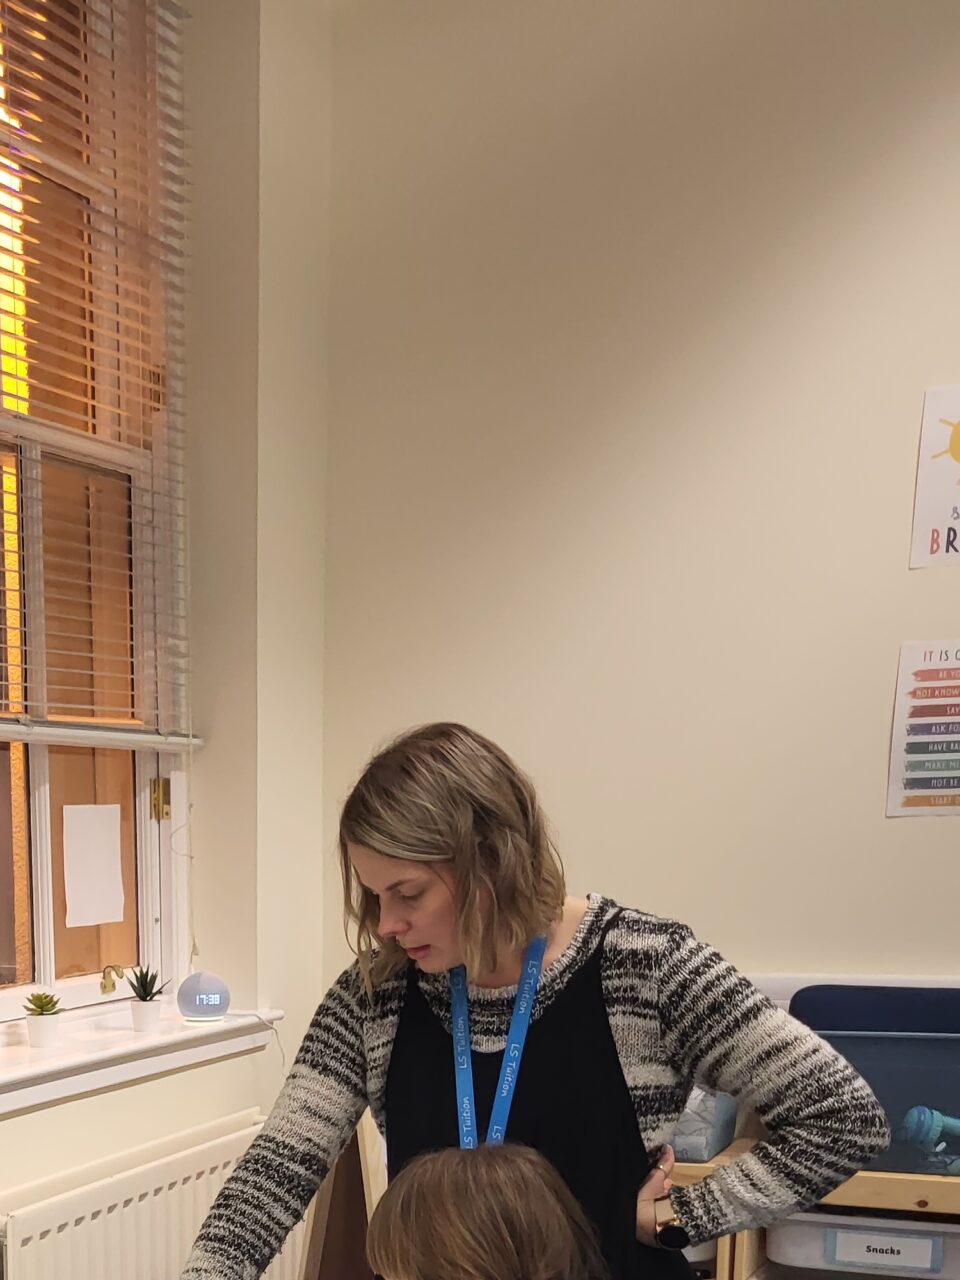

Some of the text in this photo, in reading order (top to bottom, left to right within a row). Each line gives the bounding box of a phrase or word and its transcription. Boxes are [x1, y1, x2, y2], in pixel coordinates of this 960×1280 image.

[923, 650, 934, 662] IT
[939, 649, 949, 661] IS
[916, 687, 960, 698] NOT KNOW
[946, 706, 960, 715] SAY
[931, 724, 946, 733] ASK
[928, 743, 947, 752] HAVE
[925, 760, 946, 769] MAKE
[931, 778, 946, 787] NOT
[519, 960, 539, 1014] LS Tuition
[196, 994, 221, 1005] 17:38
[457, 1016, 467, 1069] LS Tuition
[501, 1042, 520, 1097] LS Tuition
[492, 1126, 502, 1139] LS
[865, 1245, 901, 1256] Snacks
